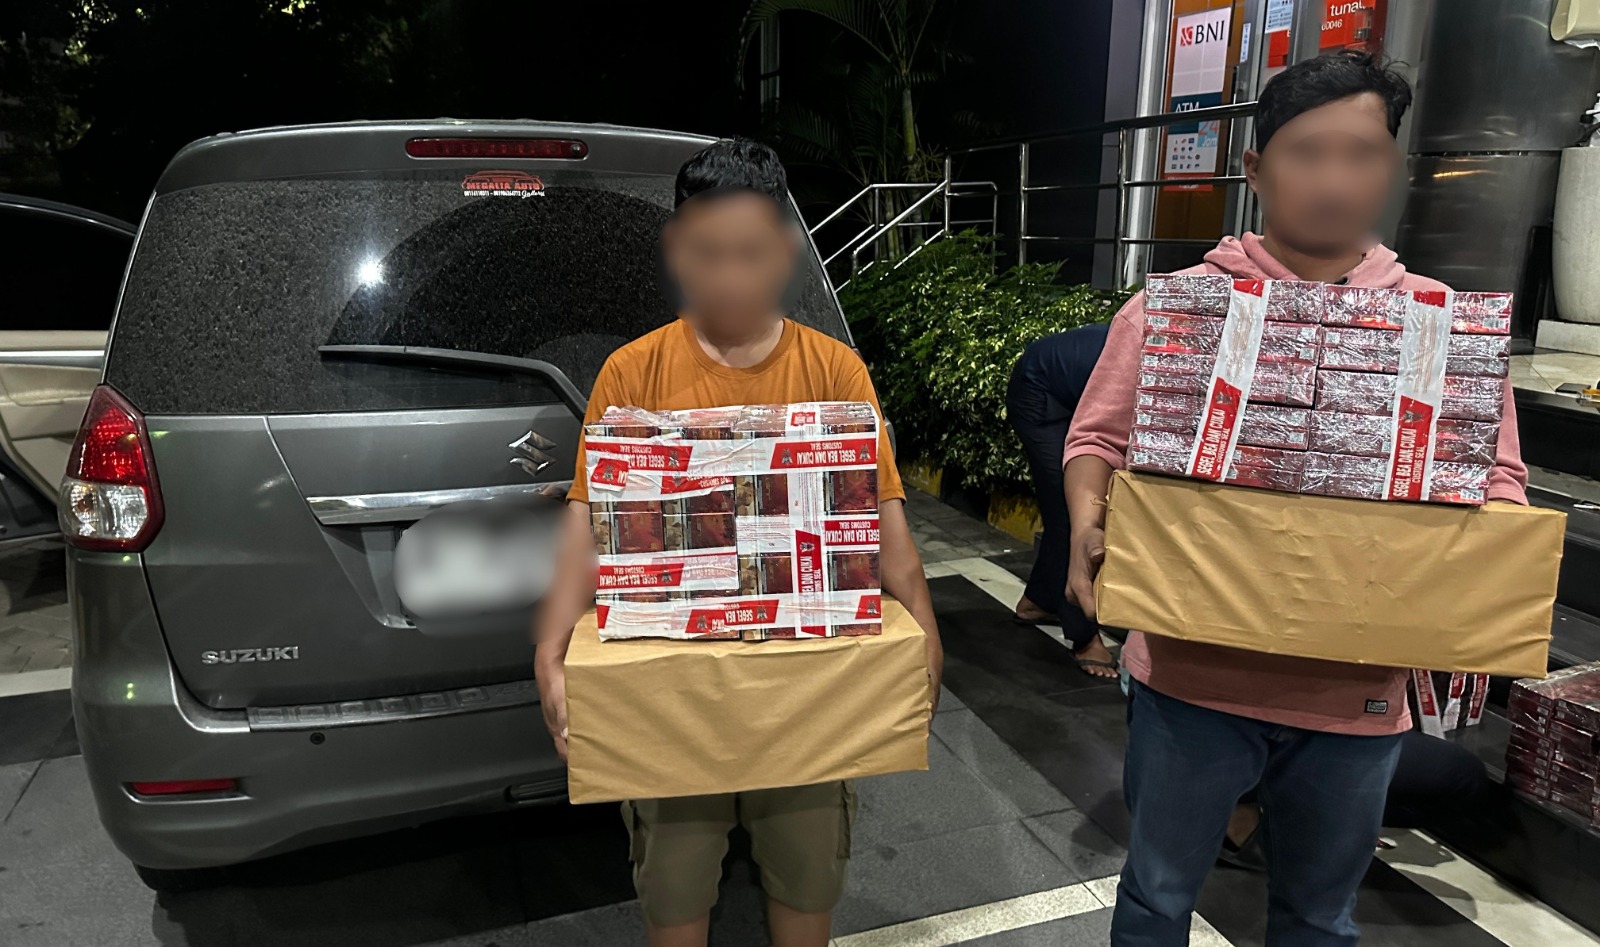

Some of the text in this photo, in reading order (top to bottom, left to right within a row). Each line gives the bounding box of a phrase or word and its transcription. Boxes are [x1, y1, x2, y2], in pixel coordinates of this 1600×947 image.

[1195, 20, 1225, 44] BNI
[1175, 101, 1199, 113] ATM
[1199, 120, 1218, 135] 24
[514, 182, 540, 190] AUTO
[1221, 428, 1230, 440] SEAL
[1197, 408, 1225, 475] SEGEL BEA DAN CUKAI
[796, 449, 857, 465] SEGEL BEA DAN CUKAI
[1393, 428, 1417, 497] SEGEL BEA DAN CUKAI
[1412, 446, 1425, 483] CUSTOMS SEAL
[839, 521, 871, 529] CUSTOMS SEAL
[825, 529, 879, 542] EGEL BEA DAN CUKAI
[800, 556, 813, 573] CUKAI
[599, 575, 616, 586] CUKAI
[629, 574, 640, 585] BEA
[801, 573, 814, 585] DAN
[725, 610, 736, 622] BEA
[736, 609, 753, 622] SEGEL
[202, 646, 299, 664] SUZUKI
